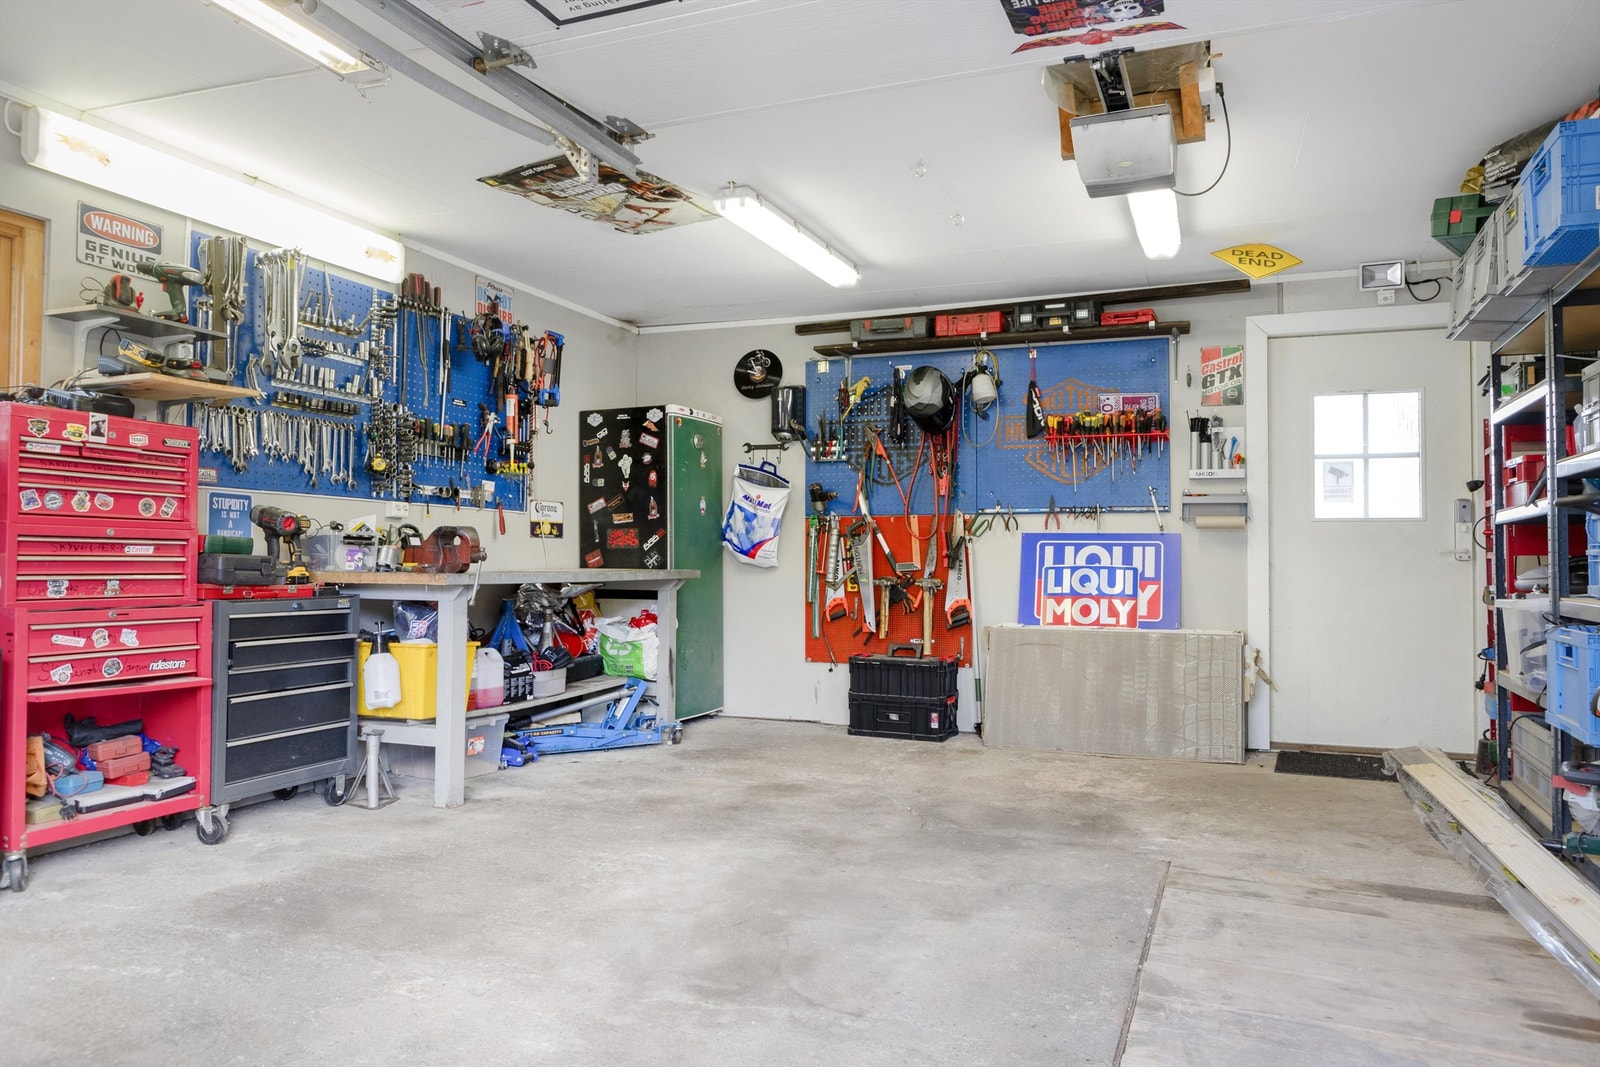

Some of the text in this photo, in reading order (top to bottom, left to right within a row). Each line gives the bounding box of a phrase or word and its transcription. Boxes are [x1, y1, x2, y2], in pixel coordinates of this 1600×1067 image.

[1037, 0, 1077, 14] HERE
[1030, 7, 1095, 24] NOTHING
[1023, 15, 1108, 35] THERE IS
[91, 214, 154, 245] WARNING
[85, 253, 104, 265] AT
[1232, 249, 1283, 260] DEAD
[1238, 257, 1276, 267] END
[1202, 352, 1243, 376] Castrol
[1202, 364, 1242, 390] GTX
[1202, 378, 1241, 396] MOTOR OIL
[34, 444, 57, 452] Castrol
[212, 497, 249, 511] STUPIDITY
[535, 502, 557, 514] Corona
[228, 520, 233, 528] A
[131, 546, 151, 554] Castrol
[1047, 568, 1134, 596] LIQUI
[1046, 597, 1136, 626] MOLY
[59, 637, 82, 645] Castrol
[149, 660, 186, 671] ridestore
